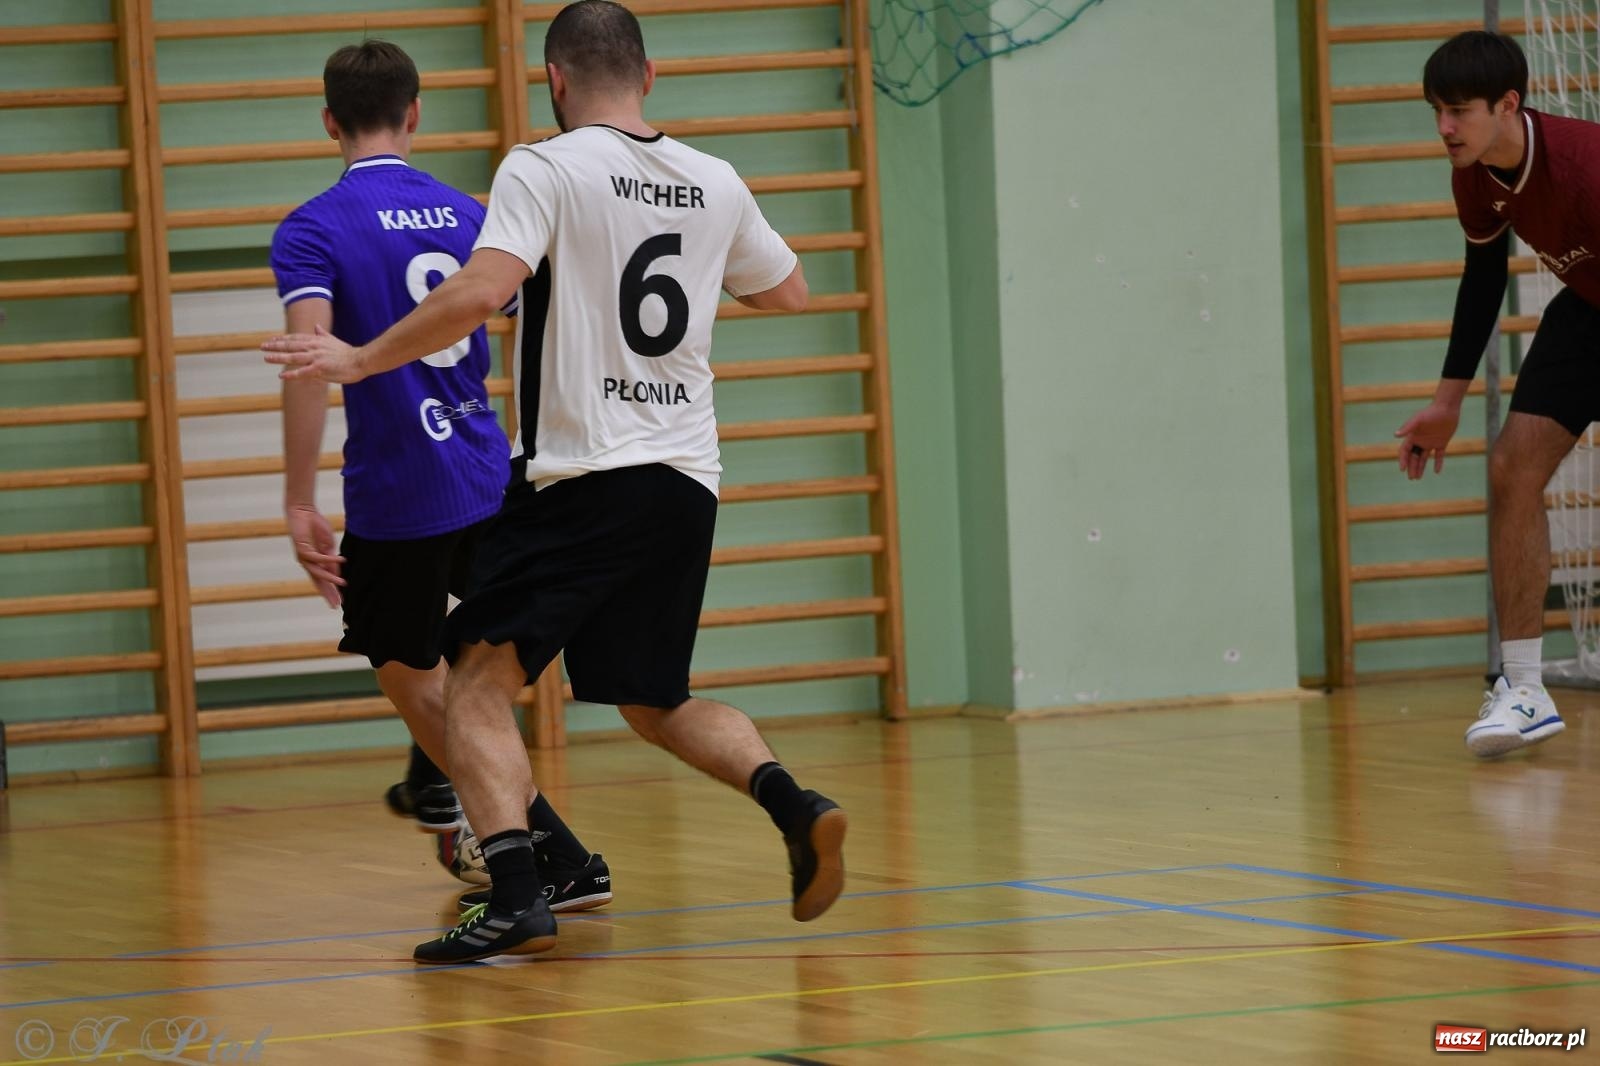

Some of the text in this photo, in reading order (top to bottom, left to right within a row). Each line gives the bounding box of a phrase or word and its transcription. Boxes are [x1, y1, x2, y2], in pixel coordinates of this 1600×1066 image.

[610, 175, 706, 209] WICHER
[377, 206, 459, 231] KAŁUS
[618, 232, 690, 358] 6
[602, 377, 692, 406] PŁONIA
